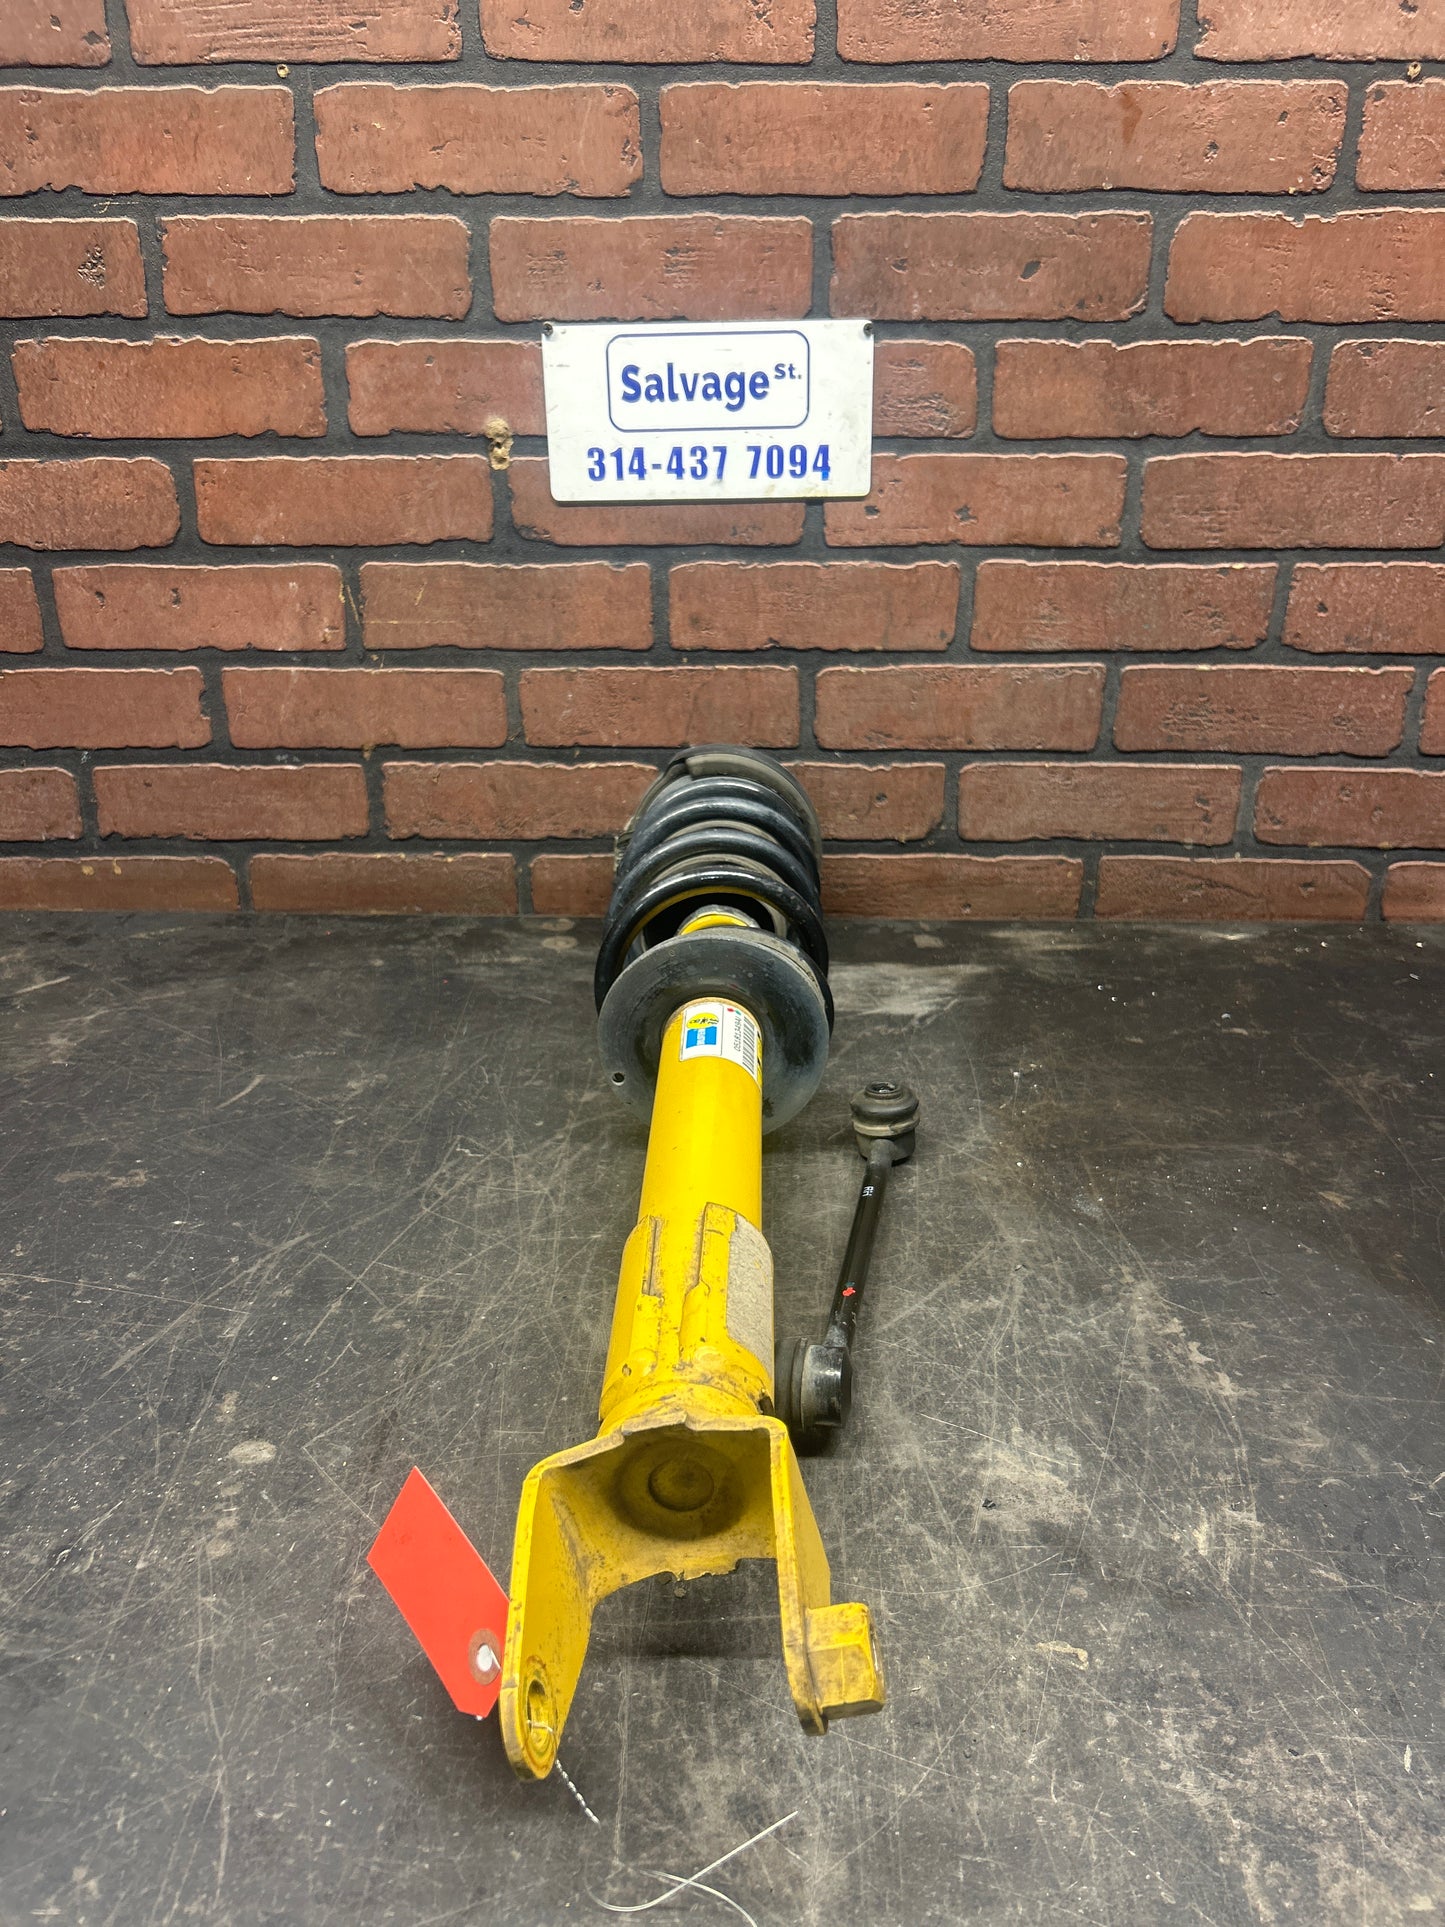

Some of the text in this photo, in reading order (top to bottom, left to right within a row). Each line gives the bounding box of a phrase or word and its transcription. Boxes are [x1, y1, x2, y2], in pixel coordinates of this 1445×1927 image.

[621, 363, 770, 412] Salvage
[587, 444, 831, 481] 314-437 7094
